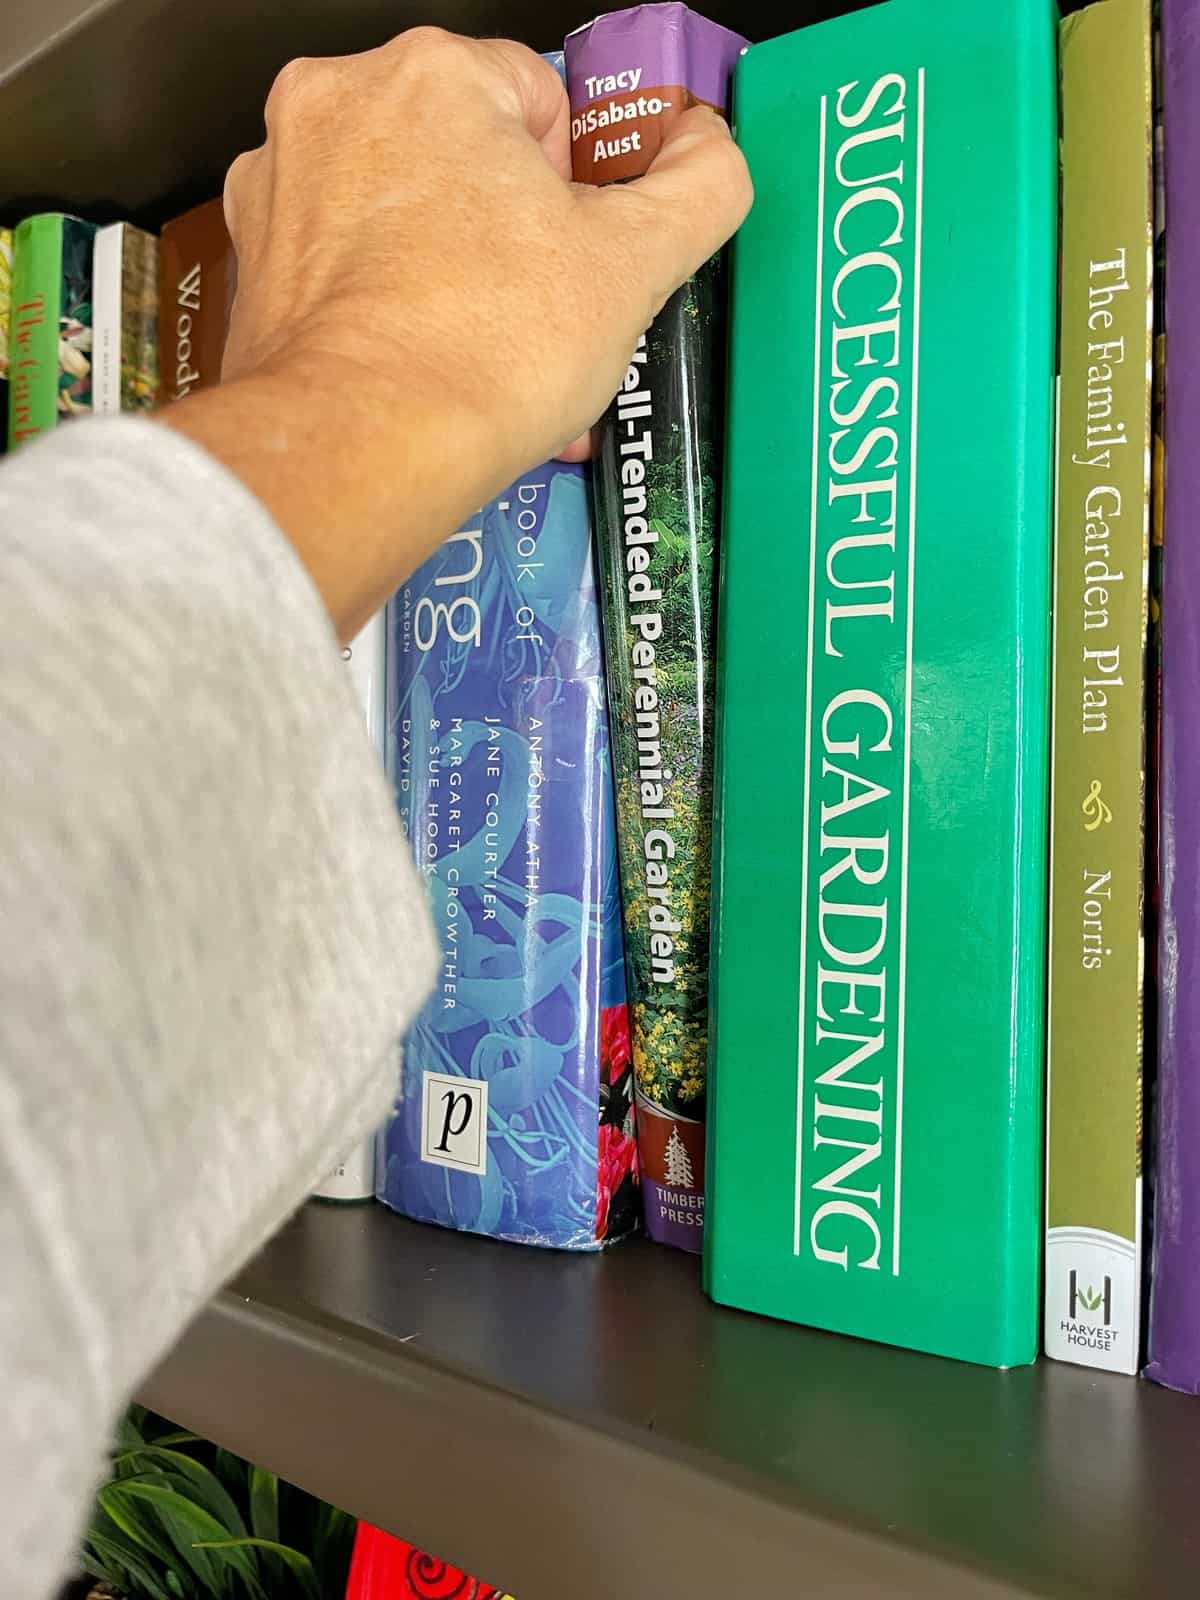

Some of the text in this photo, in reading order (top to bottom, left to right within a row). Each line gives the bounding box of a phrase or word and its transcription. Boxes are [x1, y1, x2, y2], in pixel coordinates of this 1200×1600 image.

[572, 96, 672, 142] DiSabato-
[585, 67, 642, 99] Tracy
[593, 131, 641, 163] Aust
[1072, 247, 1130, 734] The Family Garden Plan
[515, 483, 546, 647] book of
[630, 612, 675, 820] Perennial
[809, 72, 907, 1273] SUCCESSFUL GARDENING
[401, 720, 411, 792] DAVID
[427, 719, 441, 875] & SUE HOOK
[483, 716, 501, 921] JANE COURTIER
[525, 717, 543, 908] ANTONY ATHA
[444, 718, 463, 1009] MARGARET CROWTHER
[644, 829, 681, 985] Garden
[1082, 869, 1113, 970] Norris
[656, 1186, 705, 1209] TIMBER
[660, 1206, 704, 1226] PRESS
[1060, 1320, 1119, 1342] HARVEST
[1067, 1333, 1112, 1352] HOUSE
